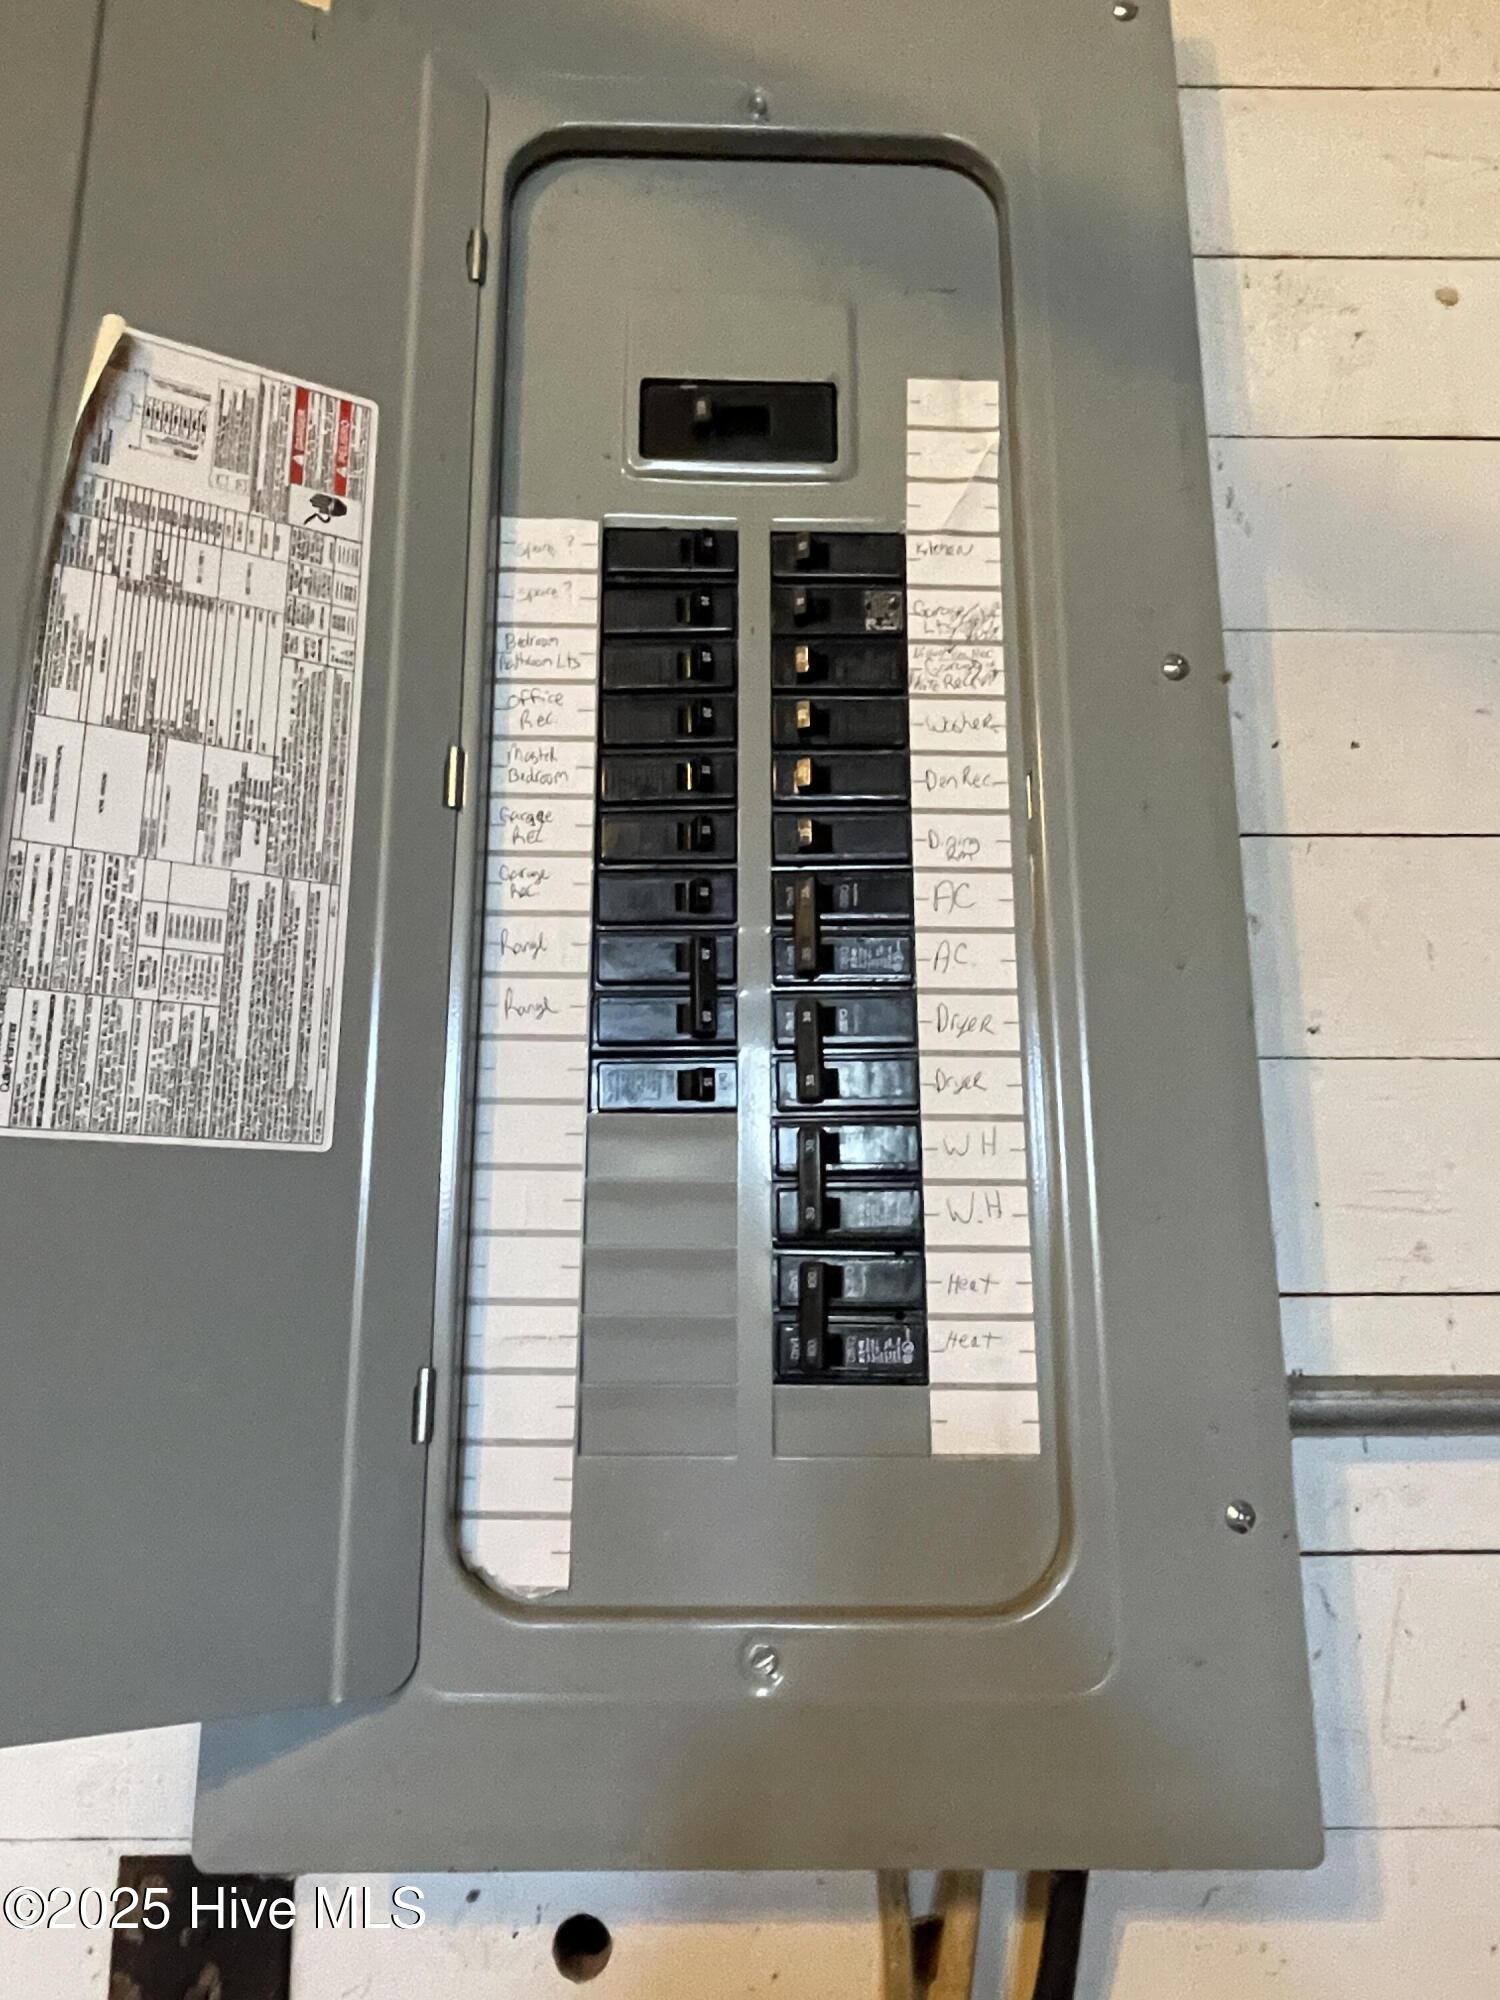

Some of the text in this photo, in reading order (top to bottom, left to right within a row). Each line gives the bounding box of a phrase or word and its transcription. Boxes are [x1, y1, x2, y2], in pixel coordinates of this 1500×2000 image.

[933, 879, 977, 914] AC
[948, 1273, 999, 1295] Heat
[945, 1331, 1003, 1350] Heat
